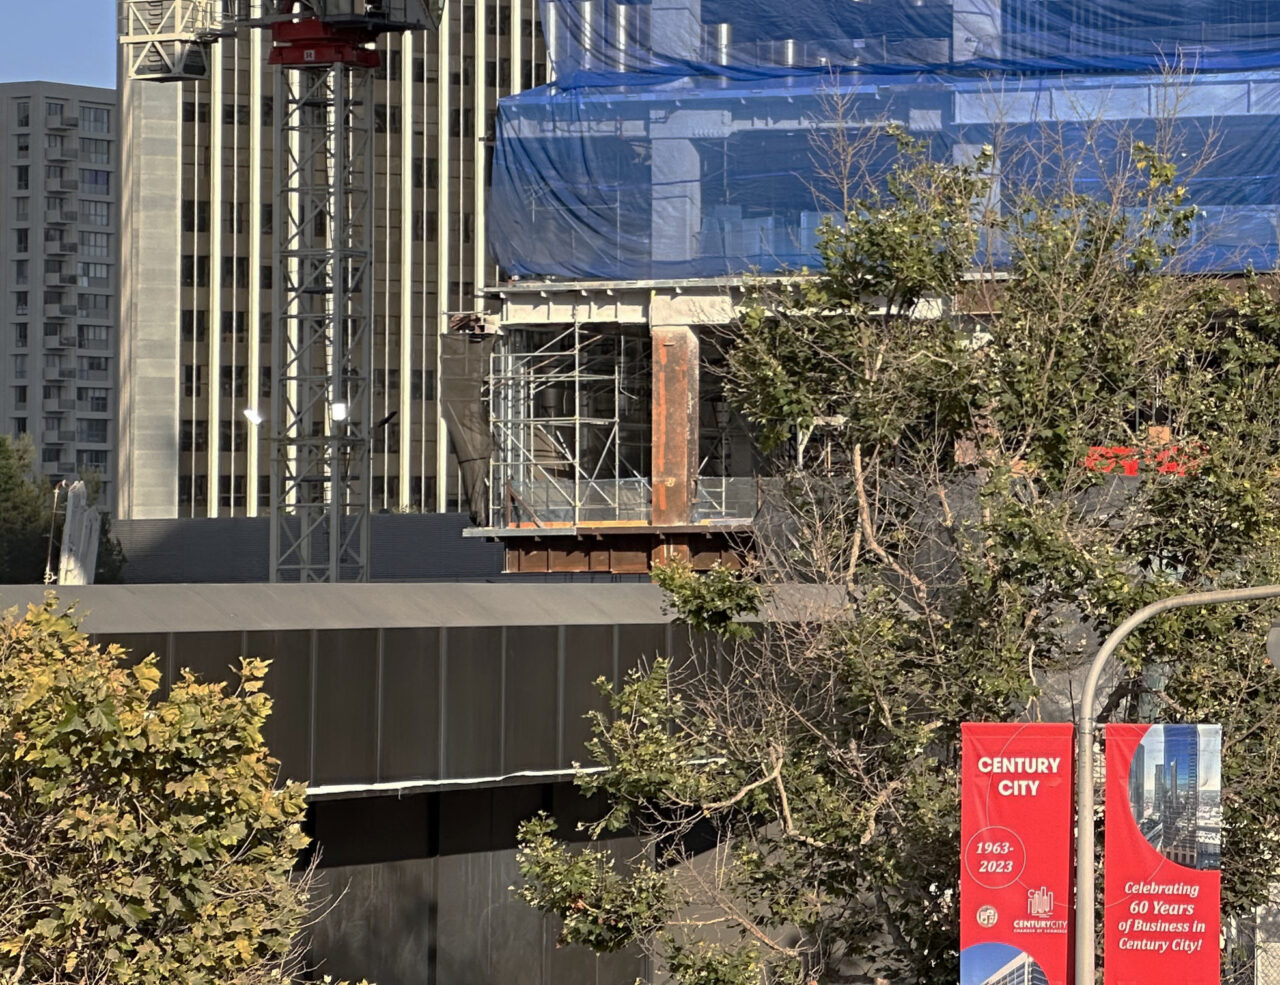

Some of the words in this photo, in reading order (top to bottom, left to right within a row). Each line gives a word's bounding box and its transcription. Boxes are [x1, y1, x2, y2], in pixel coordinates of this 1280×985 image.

[977, 756, 1061, 774] CENTURY
[998, 779, 1040, 796] CITY
[976, 842, 1015, 855] 1963-
[978, 860, 1014, 873] 2023
[1124, 881, 1200, 898] Celebrating
[1129, 900, 1150, 915] 60
[1152, 900, 1195, 915] Years
[1118, 919, 1132, 933] of
[1133, 919, 1189, 933] Business
[1192, 920, 1206, 933] in
[1118, 938, 1169, 954] Century
[1171, 937, 1203, 954] City!
